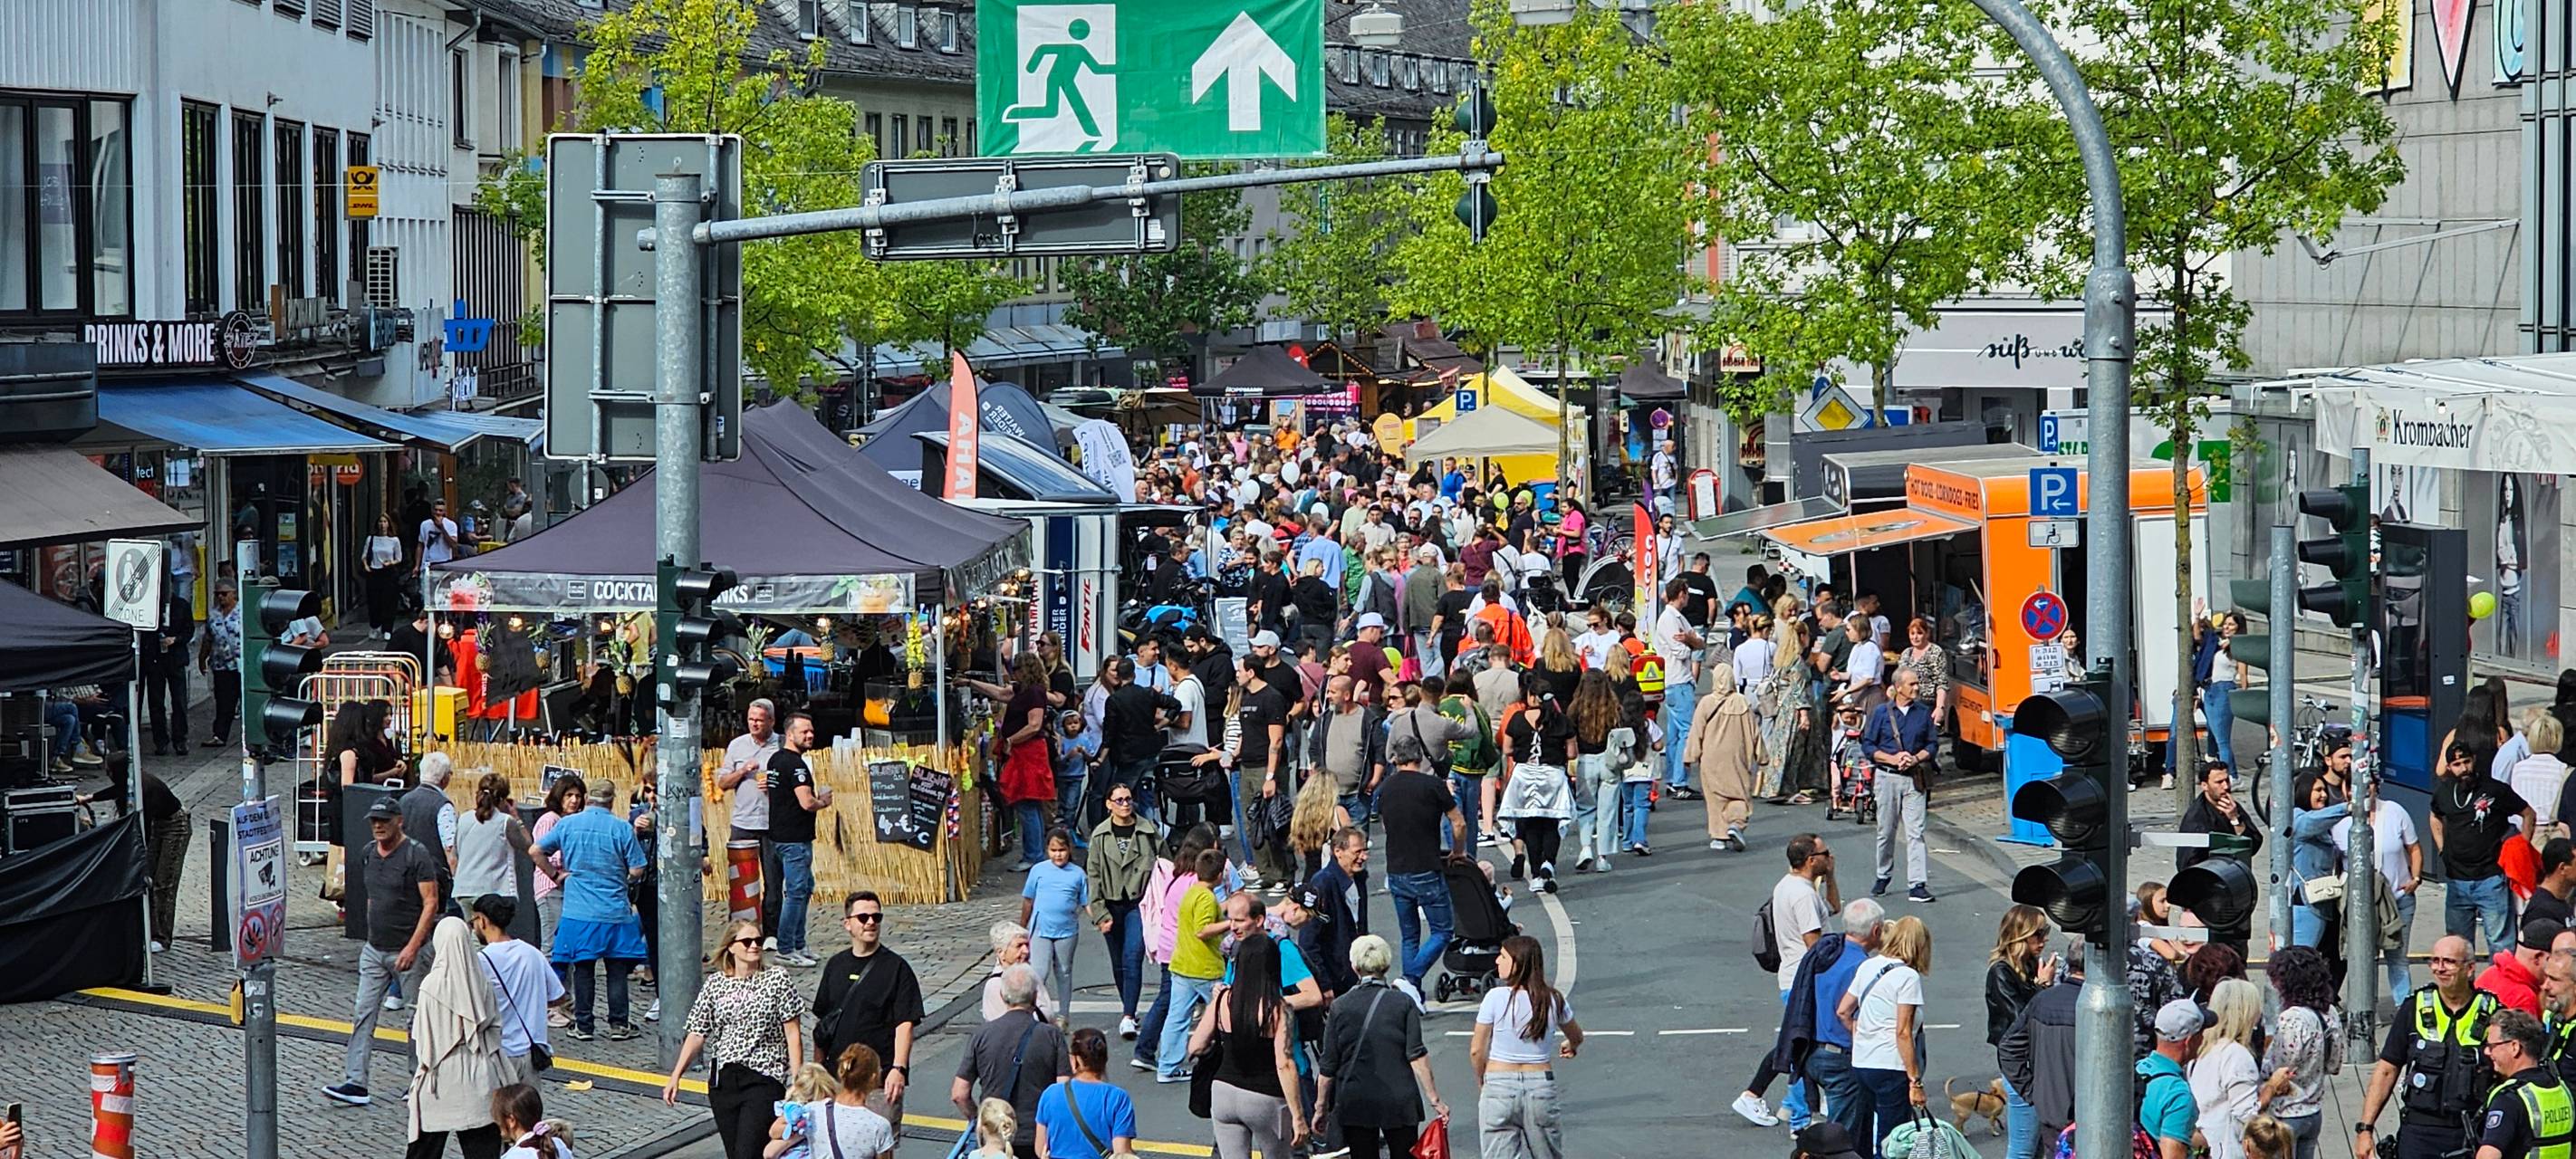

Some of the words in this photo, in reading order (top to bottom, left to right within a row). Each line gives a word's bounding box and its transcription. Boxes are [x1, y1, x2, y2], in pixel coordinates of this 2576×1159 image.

[151, 324, 166, 363] &
[168, 323, 216, 362] MORE
[1976, 333, 2038, 370] süß
[1459, 392, 1472, 408] P
[2043, 420, 2055, 447] P
[2392, 408, 2473, 449] Krombacher
[2041, 474, 2067, 511] P
[593, 580, 658, 602] COCKTA
[712, 584, 749, 604] NKS
[1081, 579, 1091, 653] FANTIC
